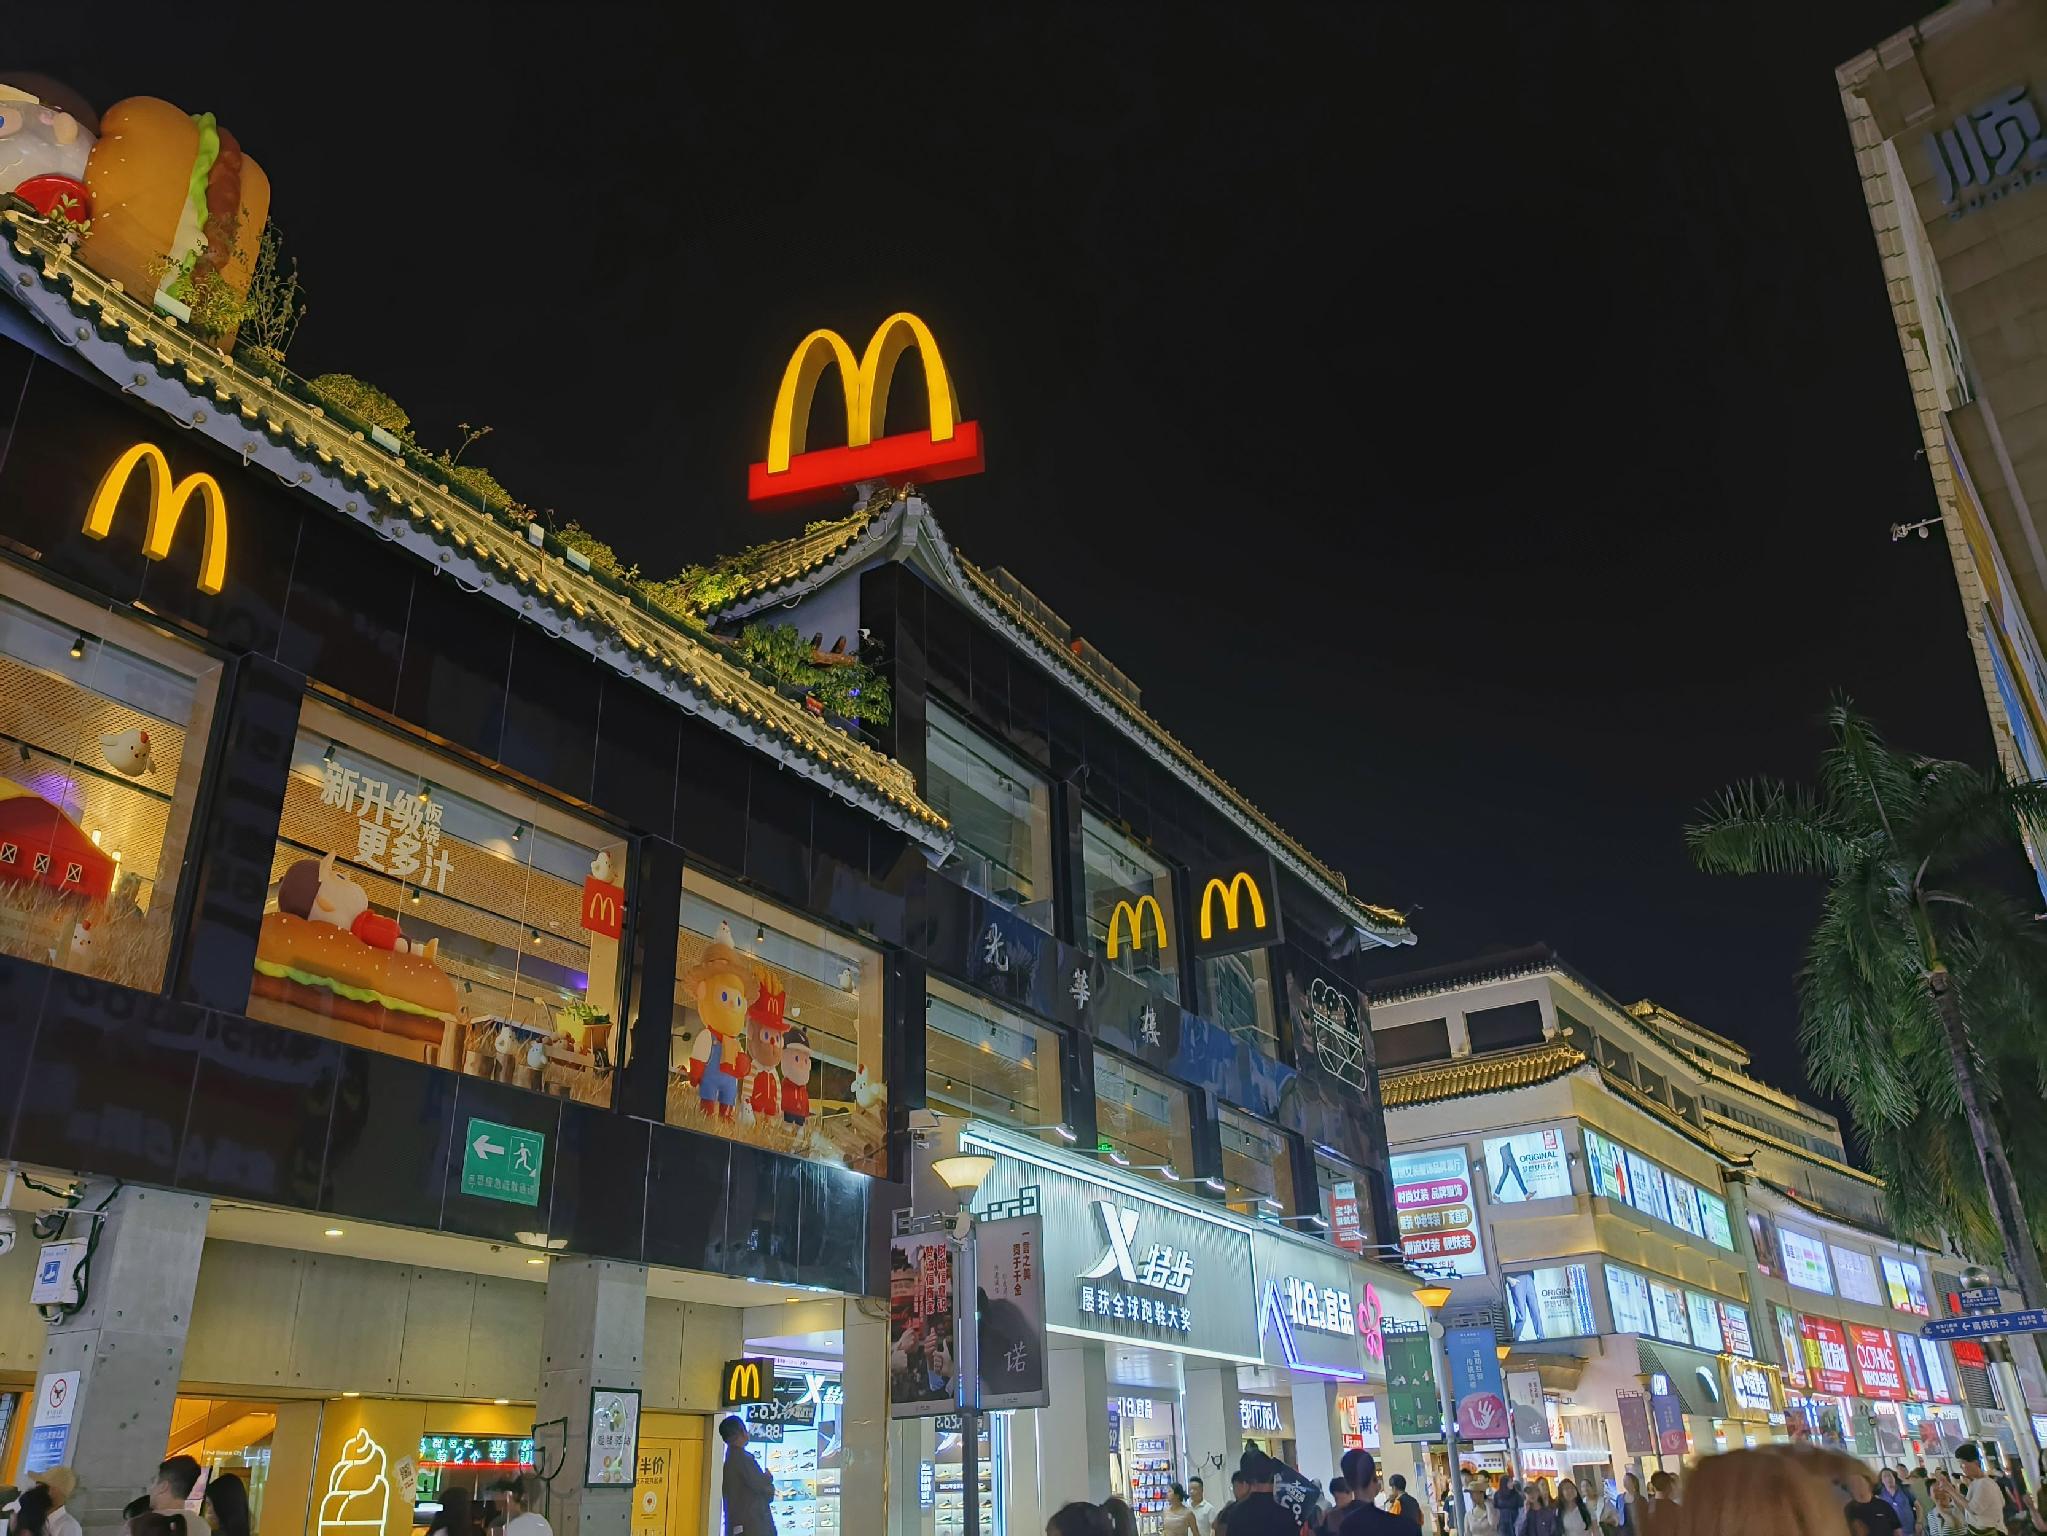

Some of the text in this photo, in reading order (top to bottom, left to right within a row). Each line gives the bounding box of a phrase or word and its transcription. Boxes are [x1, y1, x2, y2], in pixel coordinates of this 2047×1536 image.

[320, 762, 425, 839] 新升级
[352, 818, 454, 893] 更多汁
[1519, 1150, 1559, 1163] ORIGINAL
[1021, 1230, 1032, 1281] 一言之美
[1140, 1242, 1194, 1295] 特步
[1081, 1285, 1192, 1332] 屡获全球跑鞋大奖
[1239, 1400, 1283, 1431] 都市丽人
[639, 1456, 665, 1476] 半价
